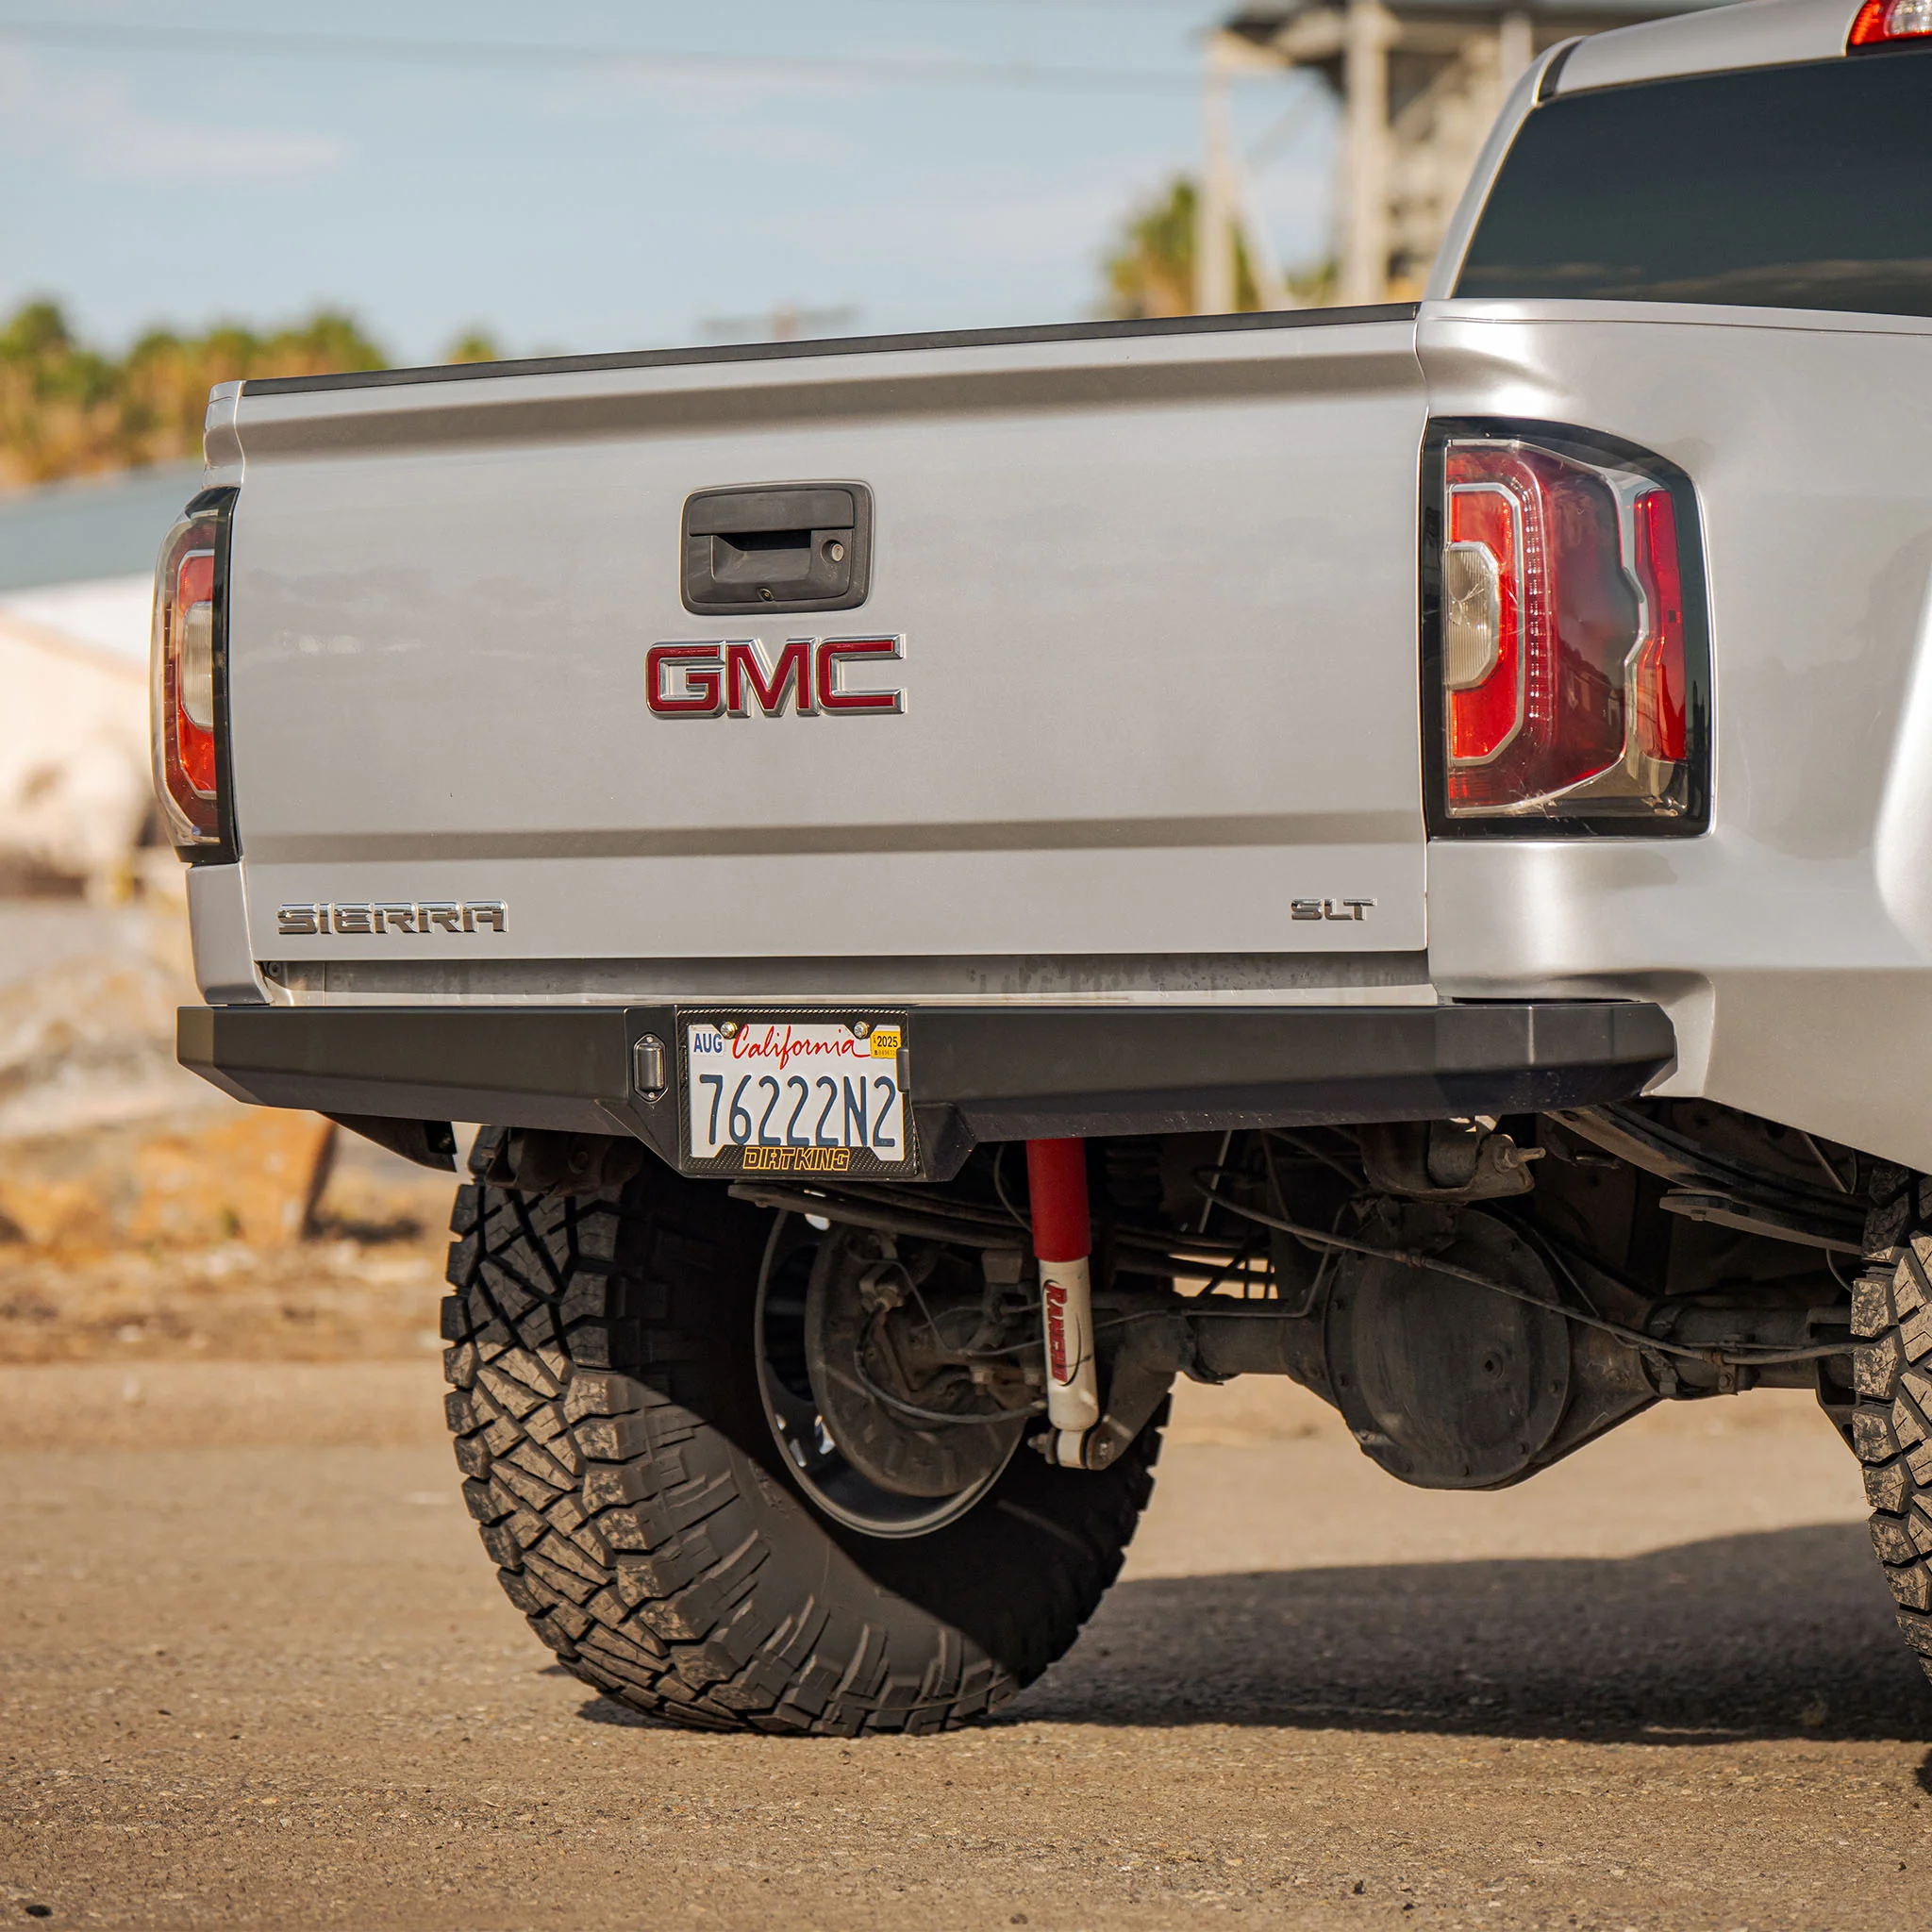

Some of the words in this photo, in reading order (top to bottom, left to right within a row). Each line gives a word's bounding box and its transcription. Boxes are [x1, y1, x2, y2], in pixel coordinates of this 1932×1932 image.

[646, 634, 907, 720] GMC
[277, 900, 509, 935] SIERRA
[1291, 898, 1377, 921] SLT
[693, 1033, 723, 1054] AUG
[732, 1024, 871, 1070] California
[877, 1035, 898, 1048] 2025
[699, 1074, 896, 1147] 76222N2
[743, 1146, 795, 1170] DIRT
[794, 1147, 851, 1171] KING
